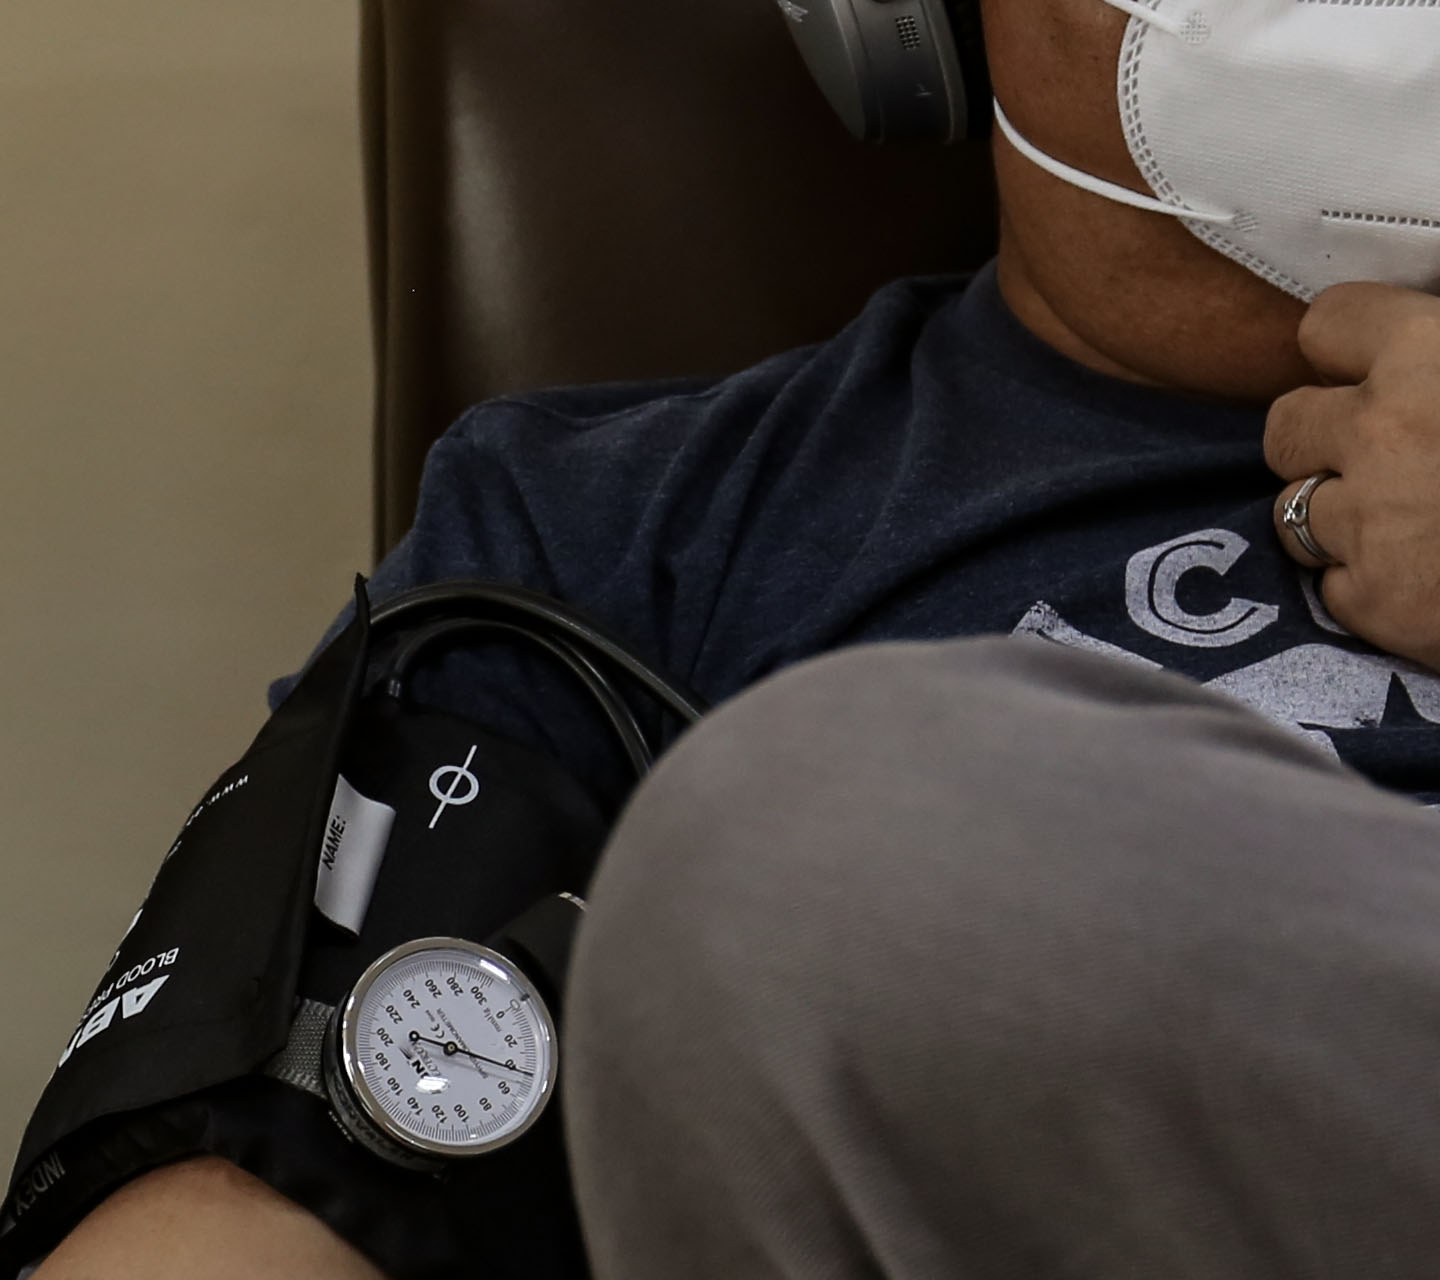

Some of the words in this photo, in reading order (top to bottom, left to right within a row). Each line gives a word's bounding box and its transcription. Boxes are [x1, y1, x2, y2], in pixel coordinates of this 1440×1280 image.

[322, 815, 346, 871] NAME:
[116, 947, 180, 989] BLOOD
[425, 979, 443, 999] 260
[446, 976, 464, 997] 280
[471, 986, 488, 1006] 300
[403, 989, 421, 1009] 240
[385, 1005, 404, 1024] 220
[496, 1010, 505, 1020] 0
[376, 1027, 394, 1047] 200
[504, 1034, 518, 1048] 20
[375, 1052, 392, 1072] 180
[387, 1077, 404, 1097] 160
[497, 1080, 511, 1095] 60
[407, 1096, 424, 1116] 140
[431, 1104, 448, 1124] 120
[453, 1103, 470, 1123] 100
[479, 1097, 493, 1112] 80
